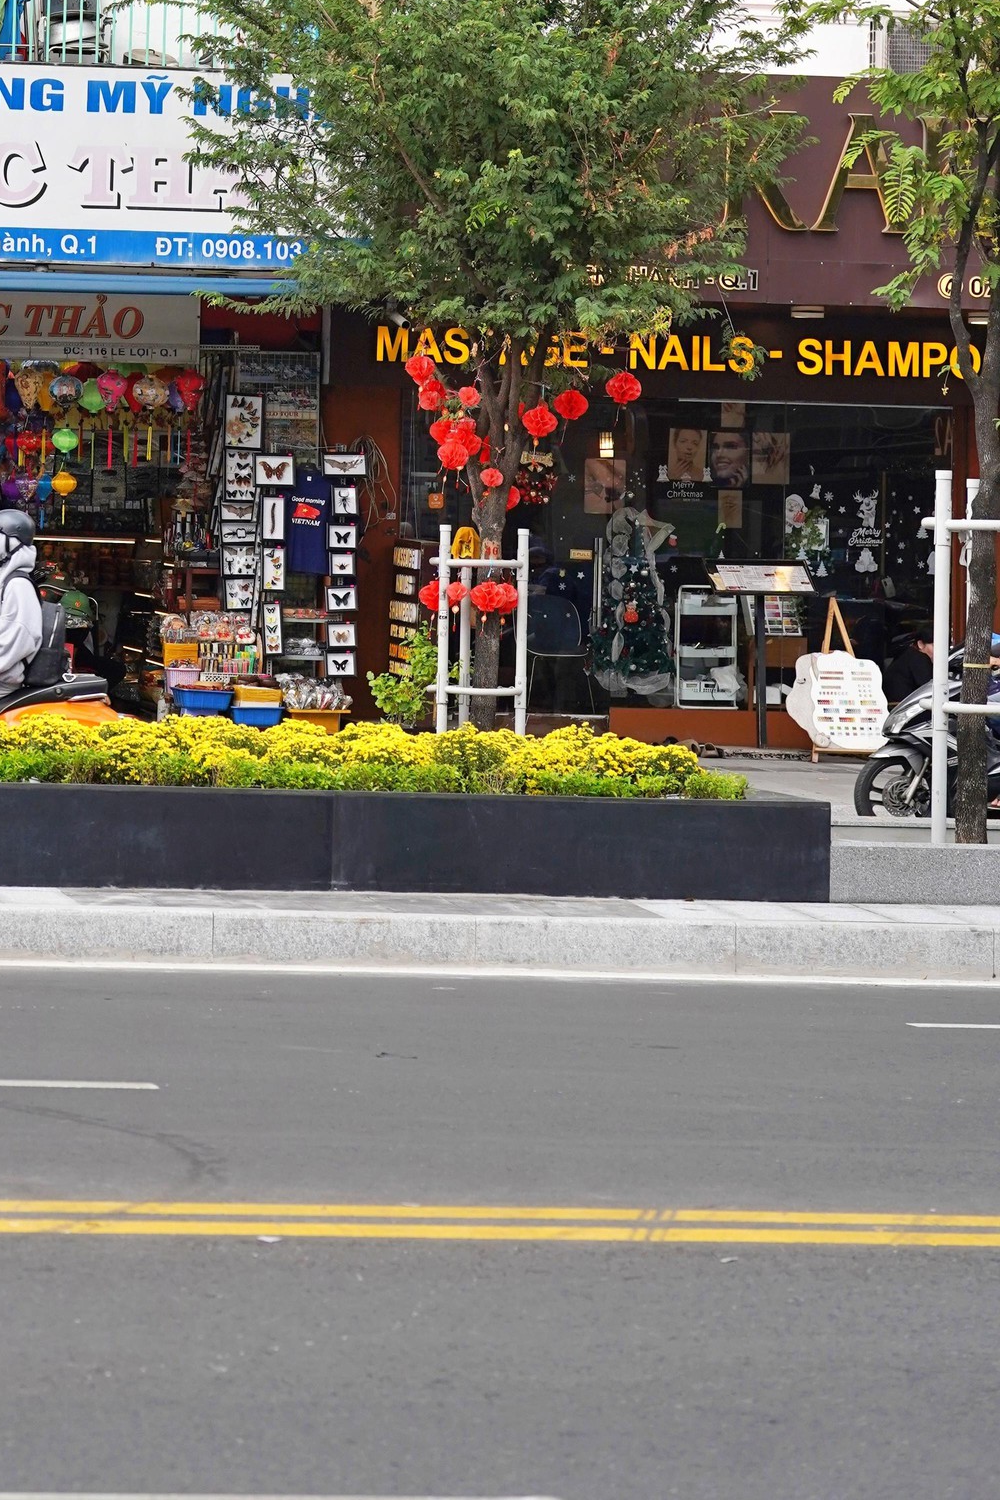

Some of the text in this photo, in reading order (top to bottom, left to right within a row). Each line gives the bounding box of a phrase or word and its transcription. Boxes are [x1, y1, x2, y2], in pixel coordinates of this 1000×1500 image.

[87, 76, 174, 114] MỸ
[61, 235, 95, 254] Q.1
[156, 238, 192, 259] ĐT:
[719, 269, 759, 292] Q.1
[24, 295, 144, 339] THẢO
[630, 332, 755, 372] NAILS
[796, 337, 981, 380] SHAMPO
[292, 518, 320, 526] VIETNAM
[852, 528, 881, 537] Merry
[848, 537, 883, 546] Christmas
